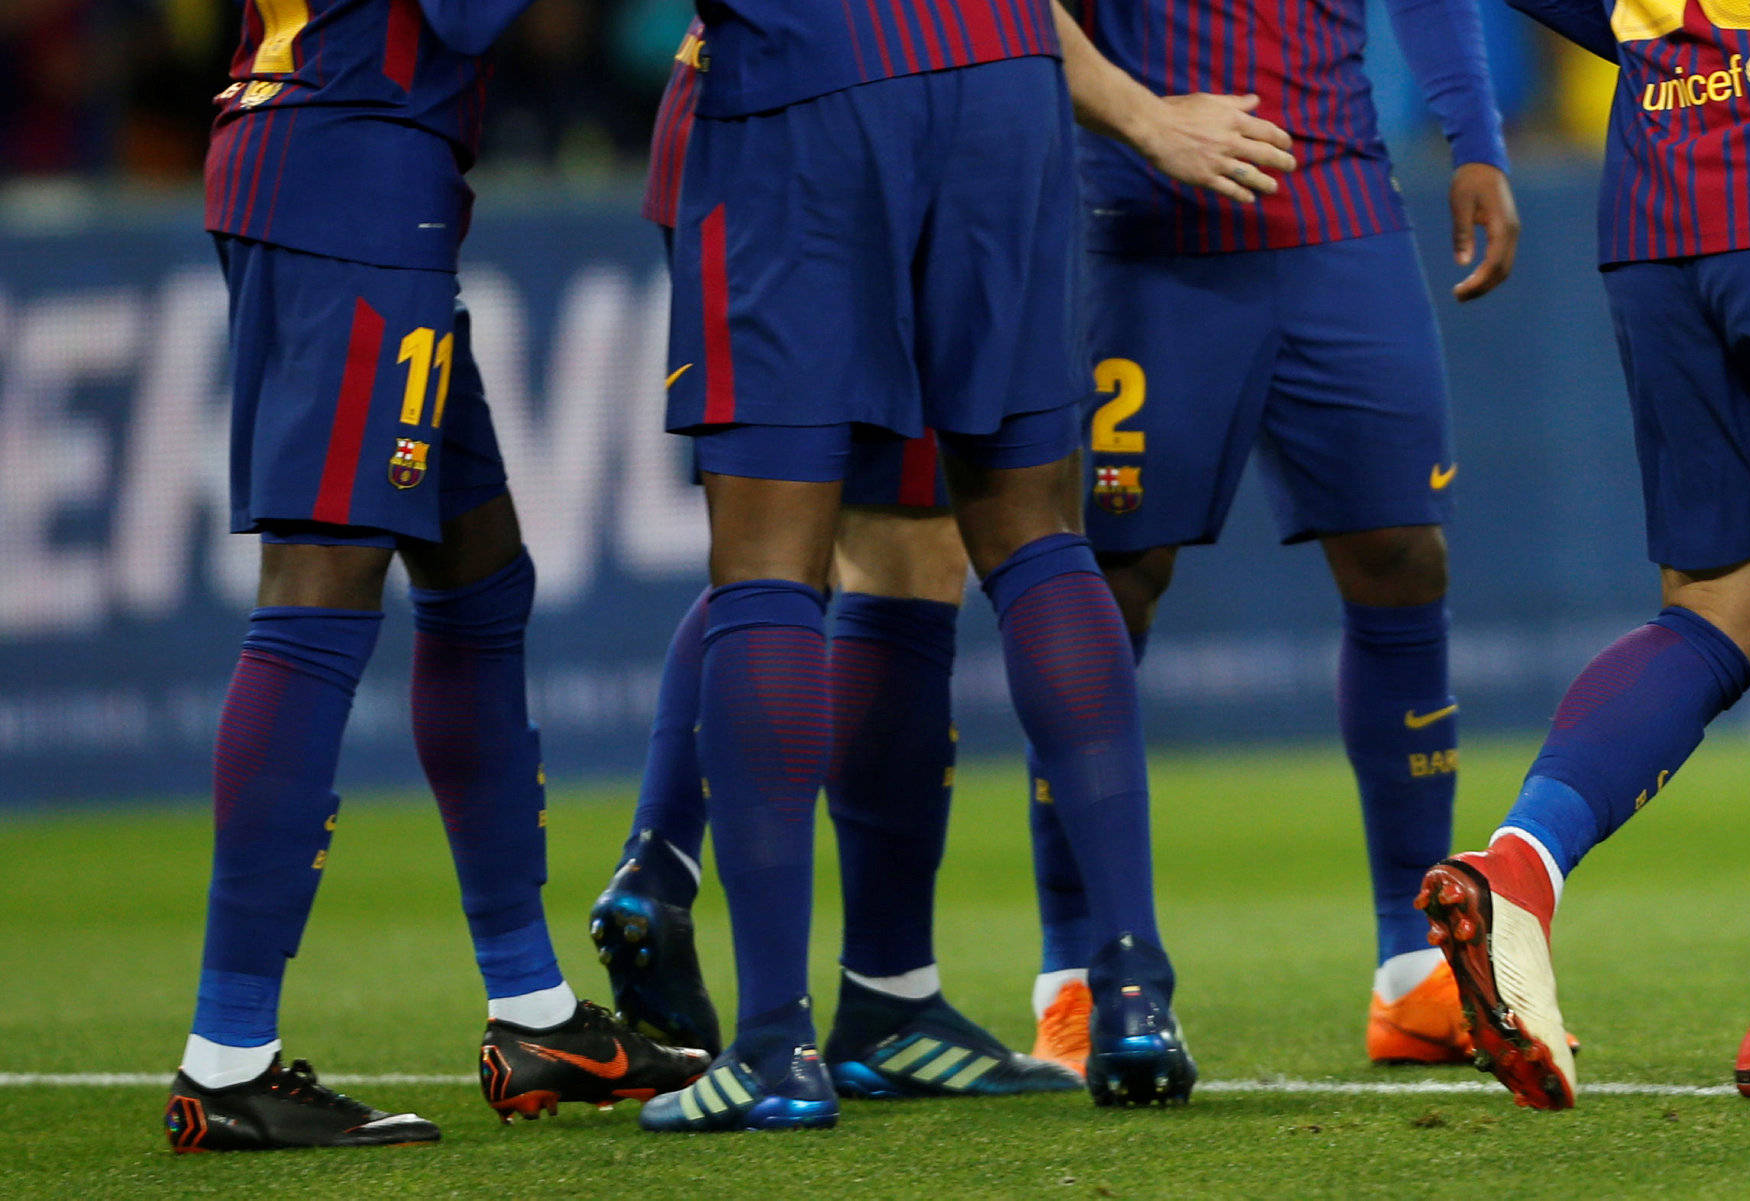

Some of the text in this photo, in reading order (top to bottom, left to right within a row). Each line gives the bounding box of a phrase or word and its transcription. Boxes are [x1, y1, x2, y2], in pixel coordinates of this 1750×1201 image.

[1642, 53, 1744, 112] unicef
[396, 326, 454, 429] 11
[1090, 357, 1147, 453] 2
